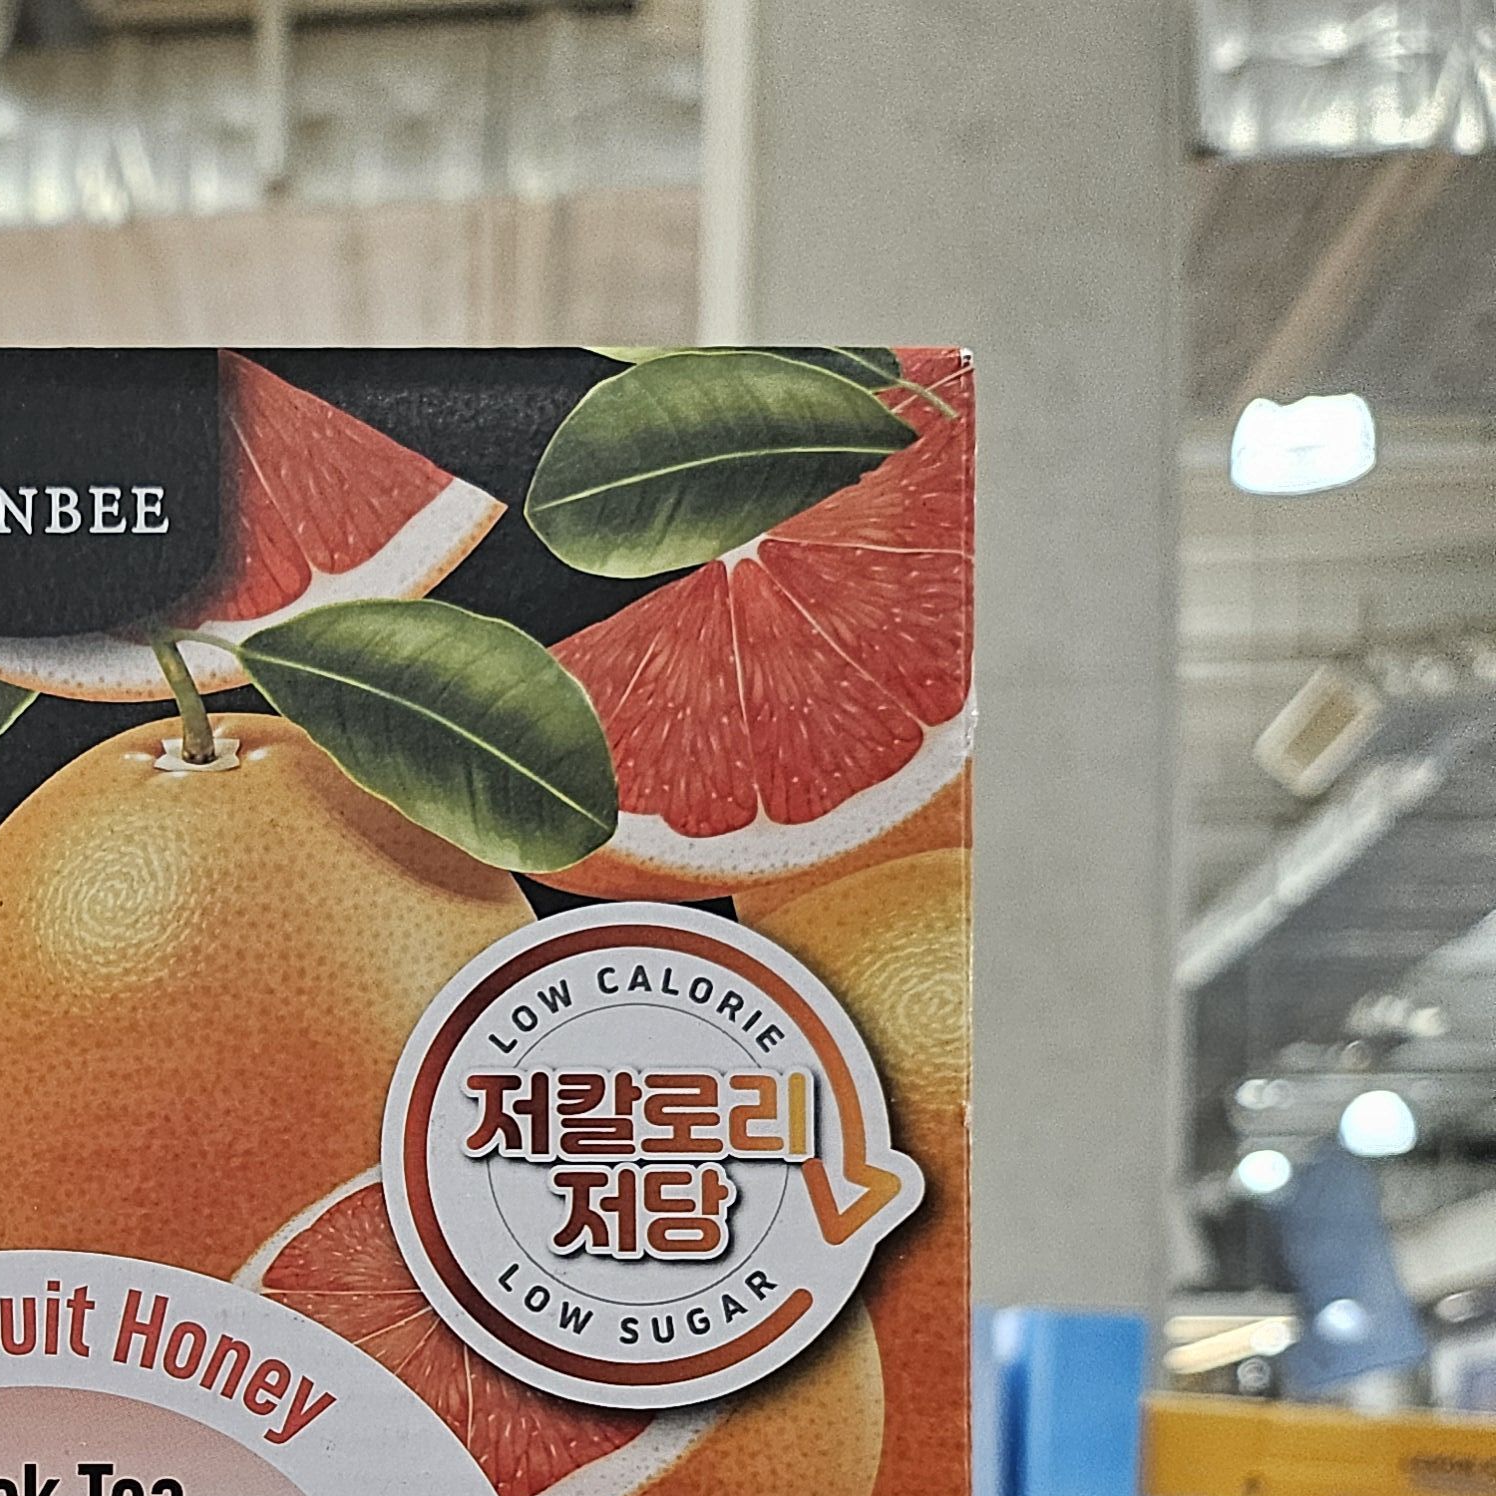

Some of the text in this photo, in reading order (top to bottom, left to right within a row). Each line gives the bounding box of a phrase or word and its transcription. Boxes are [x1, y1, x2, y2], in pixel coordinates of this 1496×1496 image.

[488, 965, 786, 1055] LOW CALORIE
[465, 1071, 807, 1156] 저칼로리
[553, 1167, 730, 1254] 저당
[498, 1262, 780, 1345] LOW SUGAR
[112, 1289, 338, 1445] Honey
